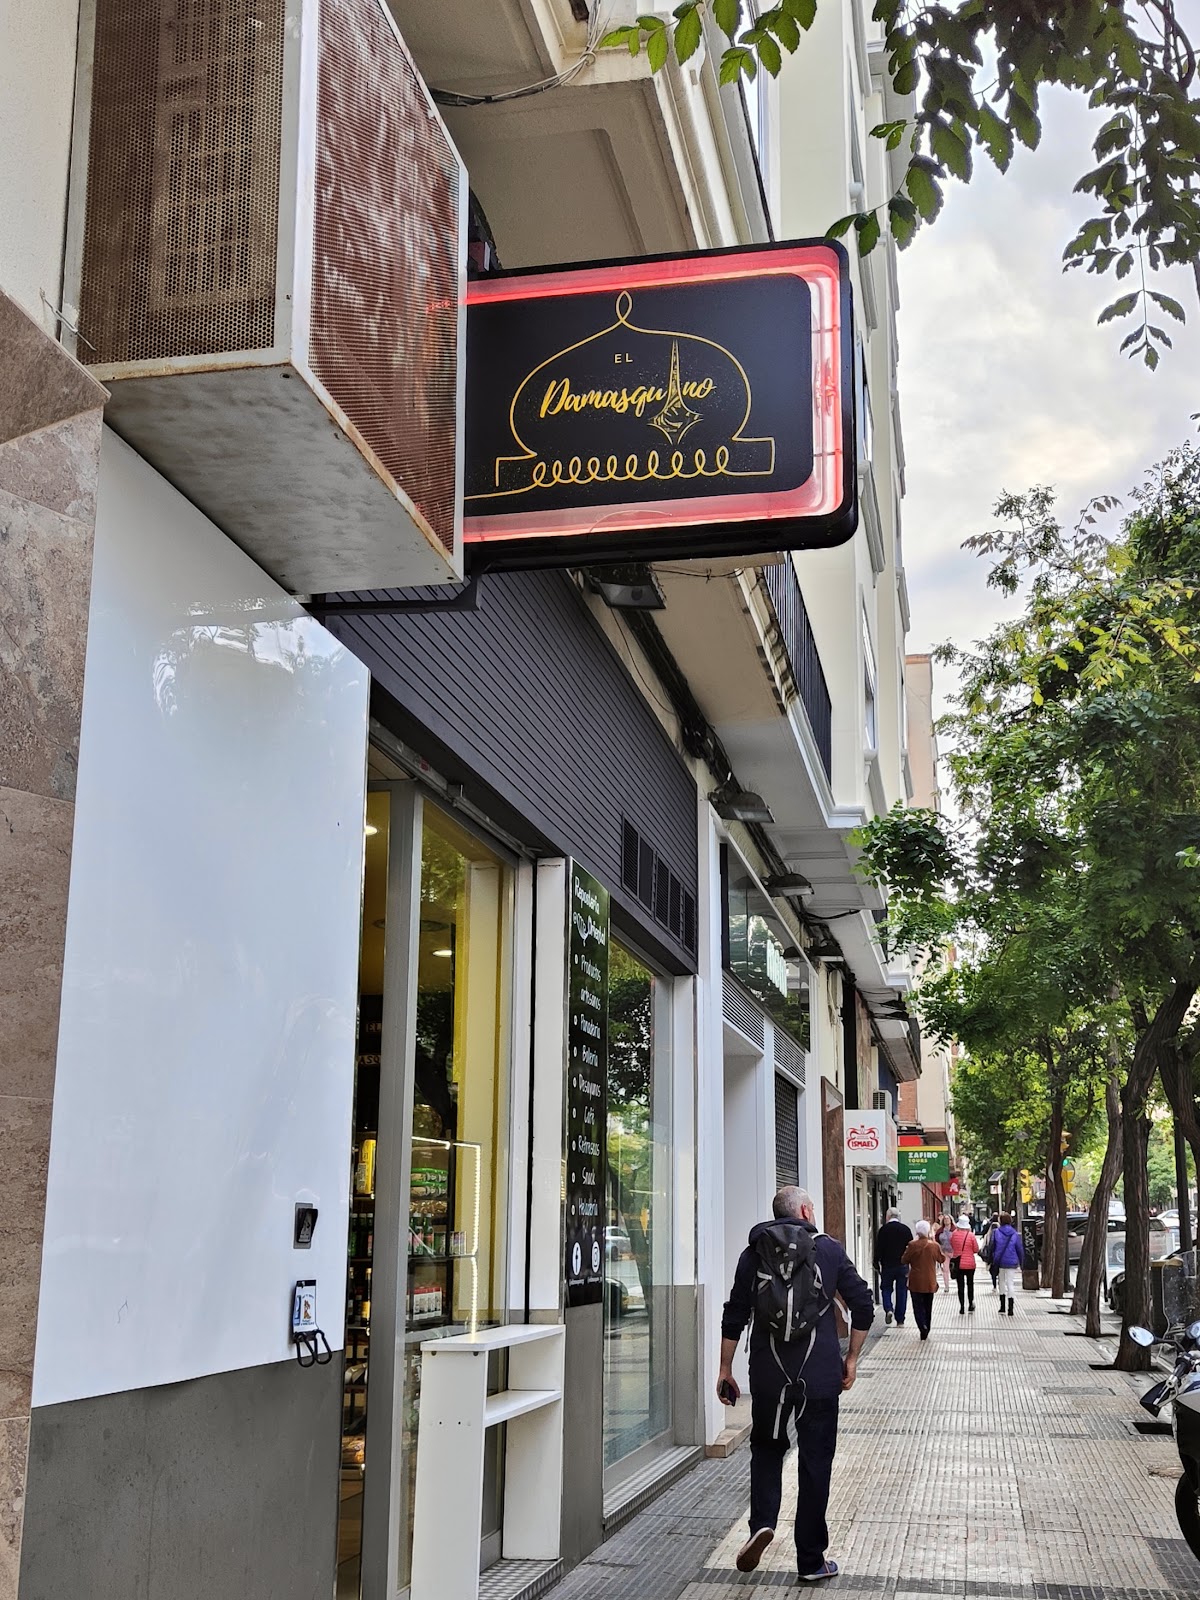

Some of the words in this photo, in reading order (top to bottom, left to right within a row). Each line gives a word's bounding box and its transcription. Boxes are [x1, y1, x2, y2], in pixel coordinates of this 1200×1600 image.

[614, 353, 634, 364] EL
[580, 954, 602, 982] Productos
[578, 1073, 602, 1101] Desayunos
[577, 1134, 601, 1157] Refrescos
[851, 1140, 875, 1148] ISMAEL
[908, 1151, 939, 1159] ZAFIRO
[908, 1174, 927, 1182] renfe
